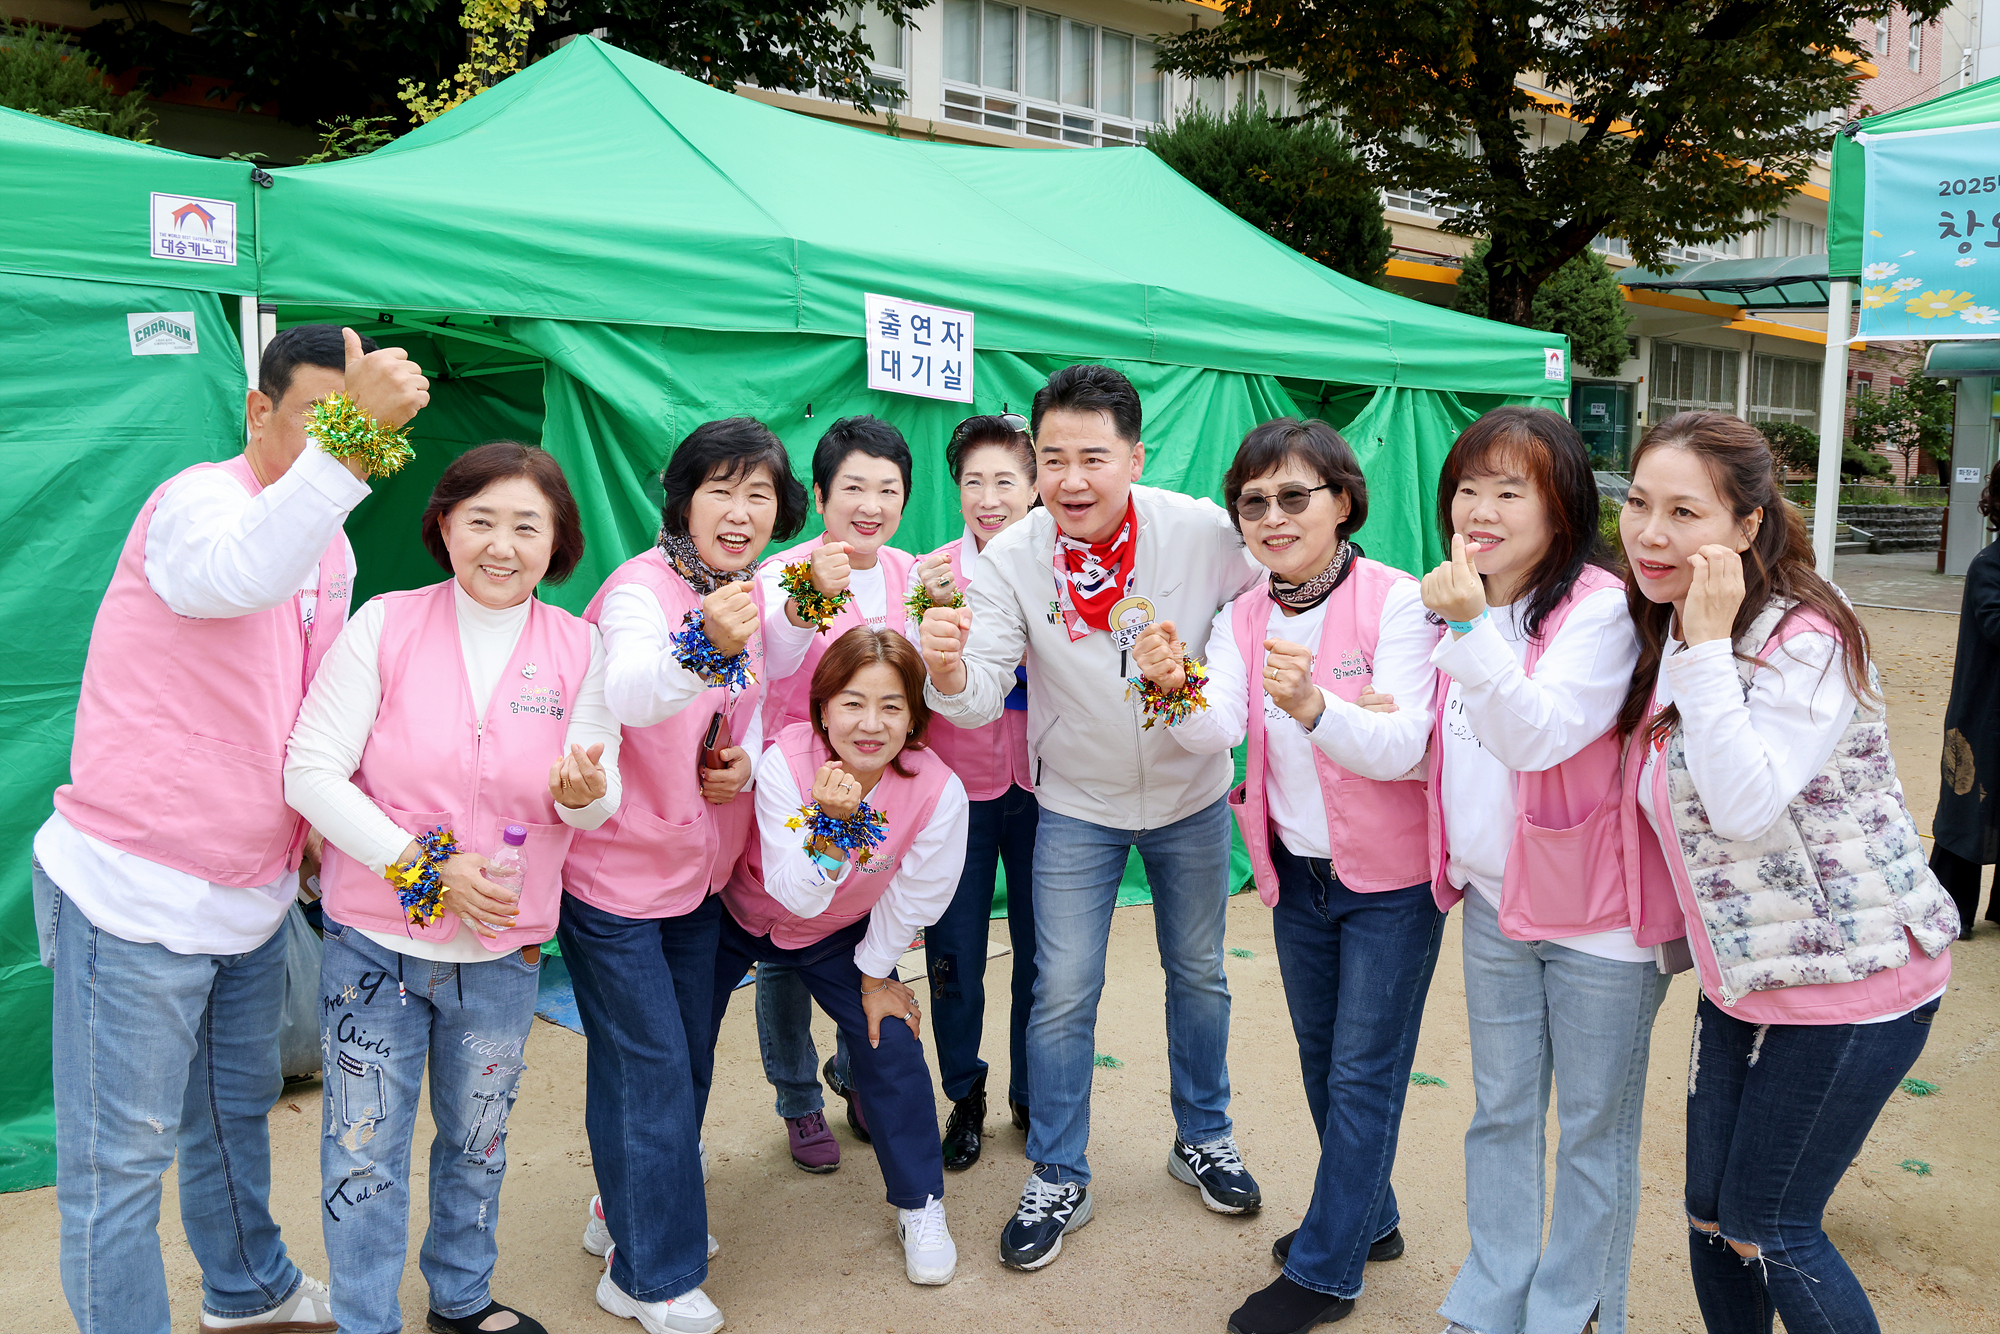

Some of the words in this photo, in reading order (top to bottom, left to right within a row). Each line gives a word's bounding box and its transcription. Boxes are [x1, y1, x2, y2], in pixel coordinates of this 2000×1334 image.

[161, 238, 226, 259] 대승캐노피
[135, 319, 191, 342] CARAVAN
[878, 307, 964, 352] 출연자
[881, 349, 962, 391] 대기실
